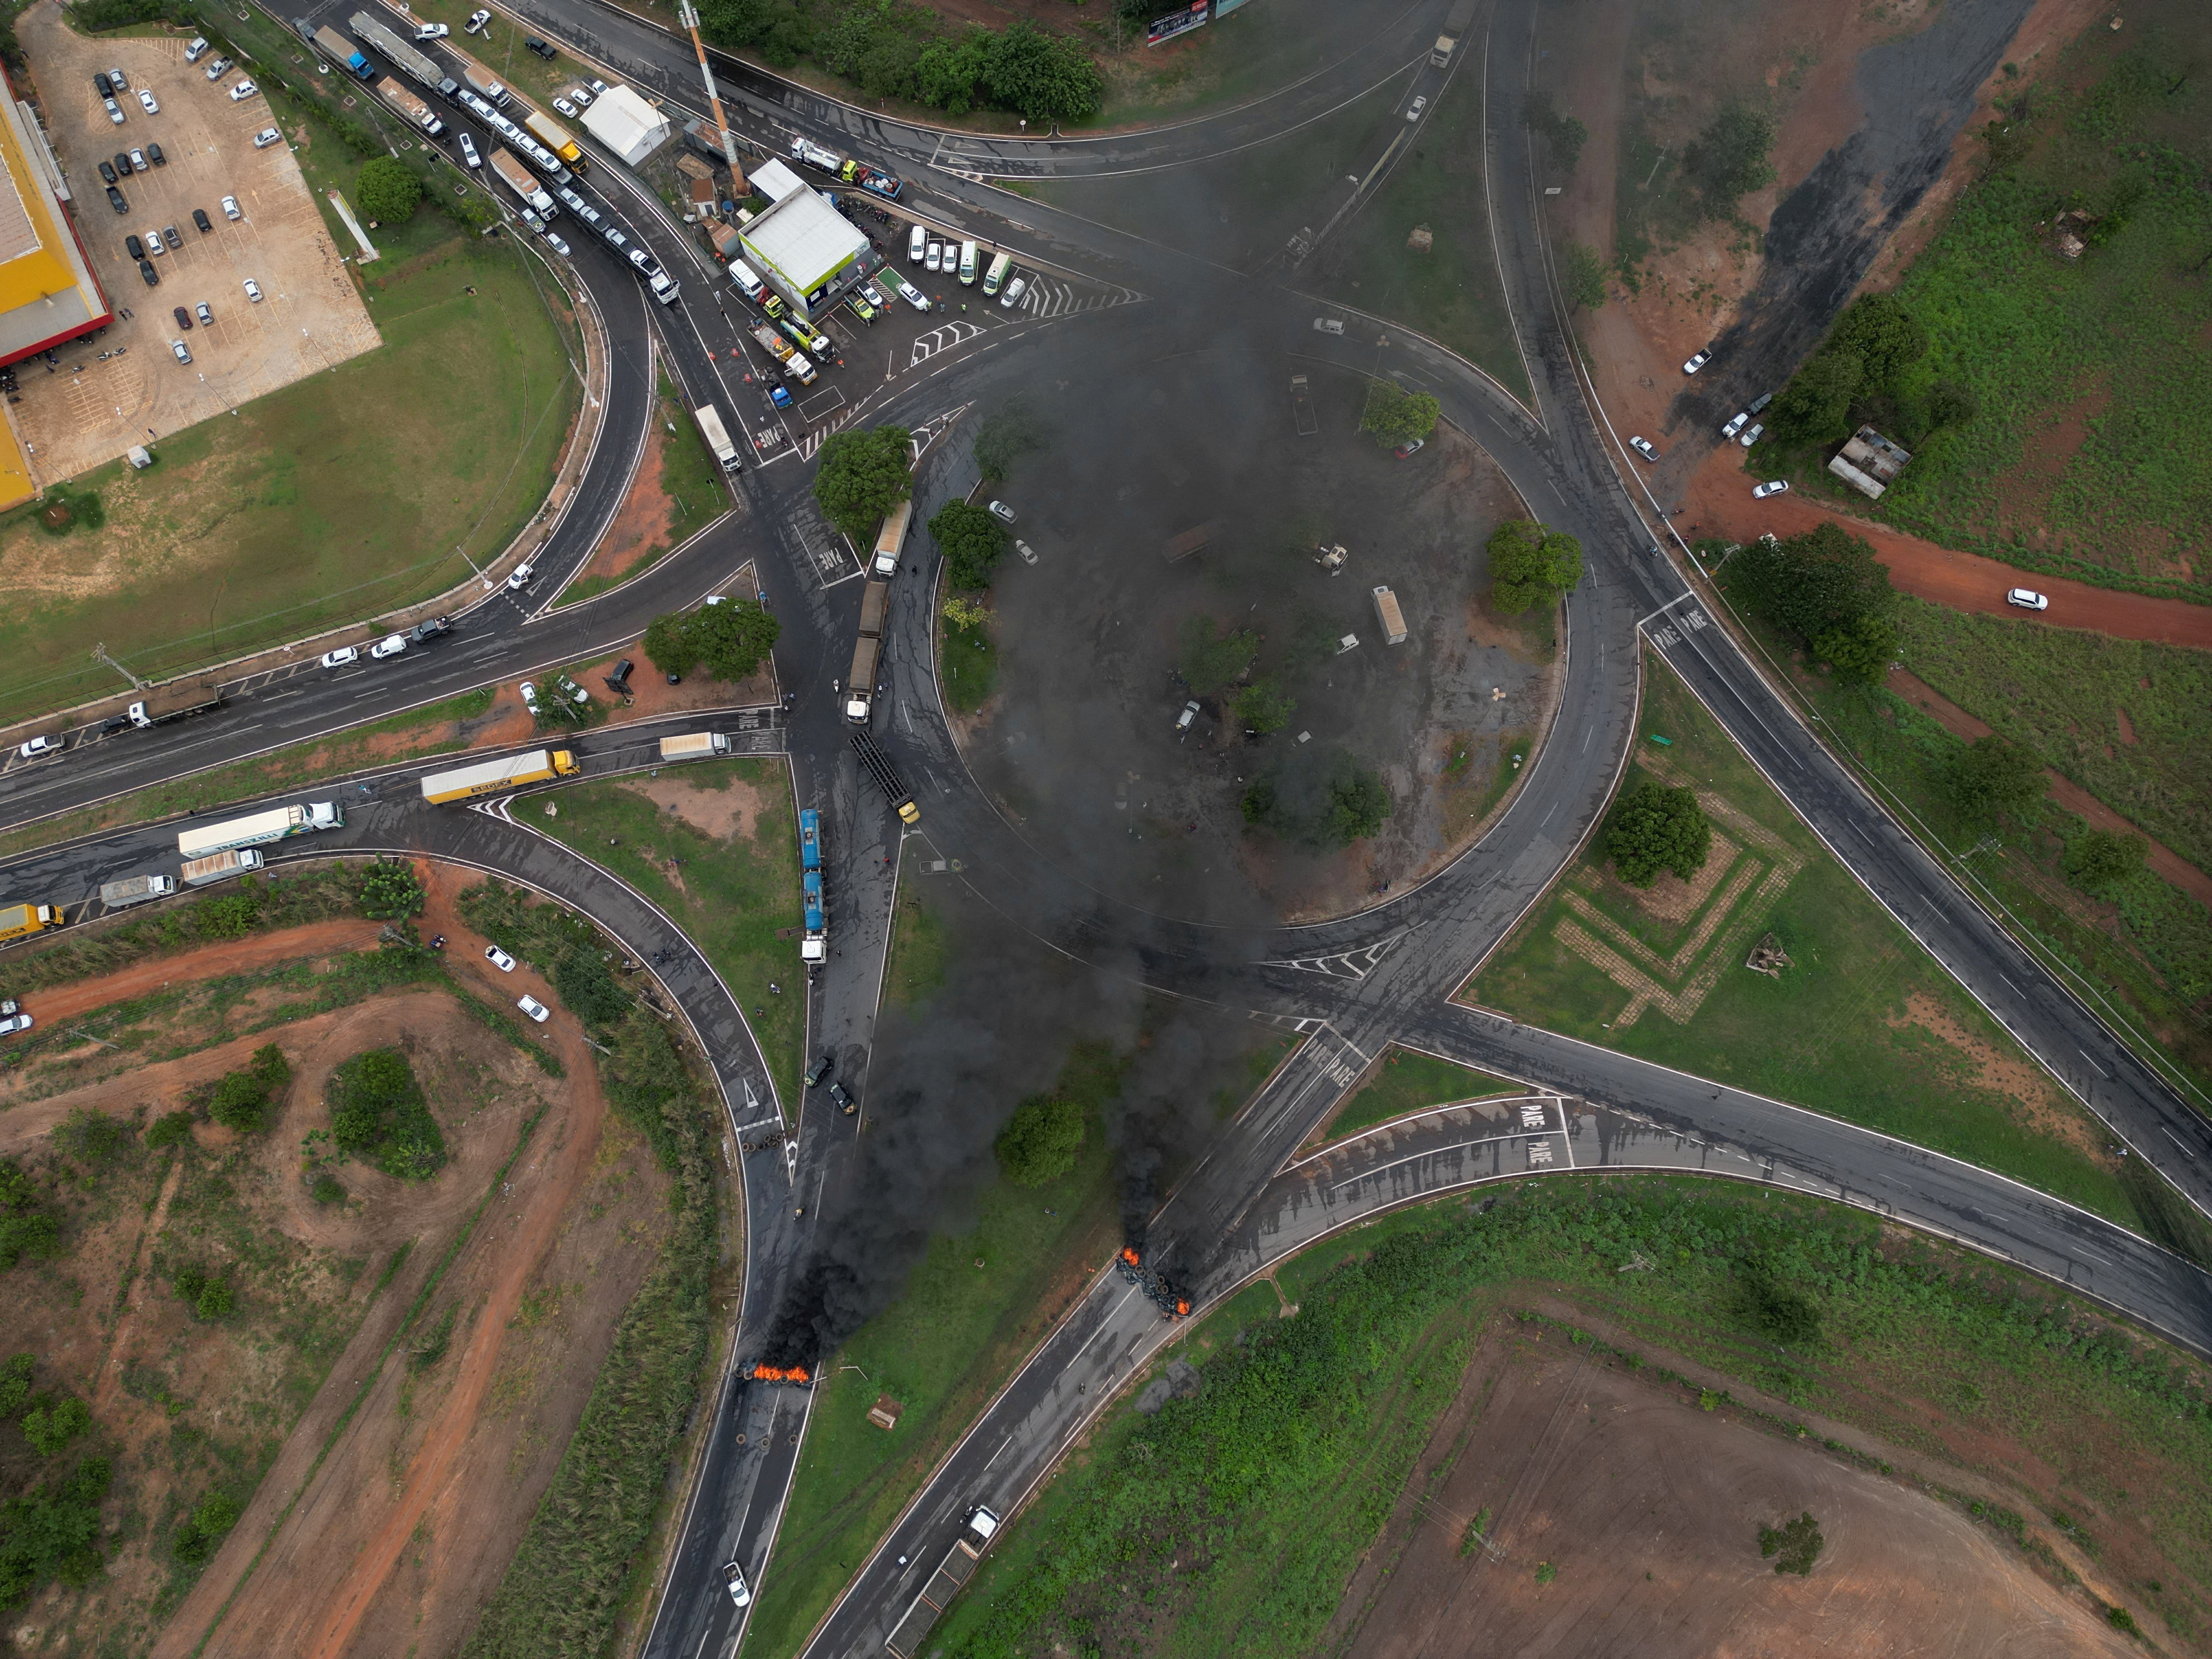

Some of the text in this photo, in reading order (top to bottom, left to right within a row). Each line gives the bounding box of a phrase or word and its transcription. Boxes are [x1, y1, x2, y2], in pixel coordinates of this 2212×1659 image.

[758, 426, 781, 448] PARE
[819, 548, 844, 570] PARE
[1680, 610, 1708, 633] PARE
[1654, 625, 1681, 650] PARE
[738, 709, 759, 729] PARE
[473, 780, 511, 792] SEDEX
[215, 833, 278, 850] TRANSZILLI
[1303, 1038, 1333, 1069] PARE
[1325, 1058, 1355, 1088] PARE
[1520, 1105, 1545, 1128] PARE
[1528, 1141, 1553, 1164] PARE
